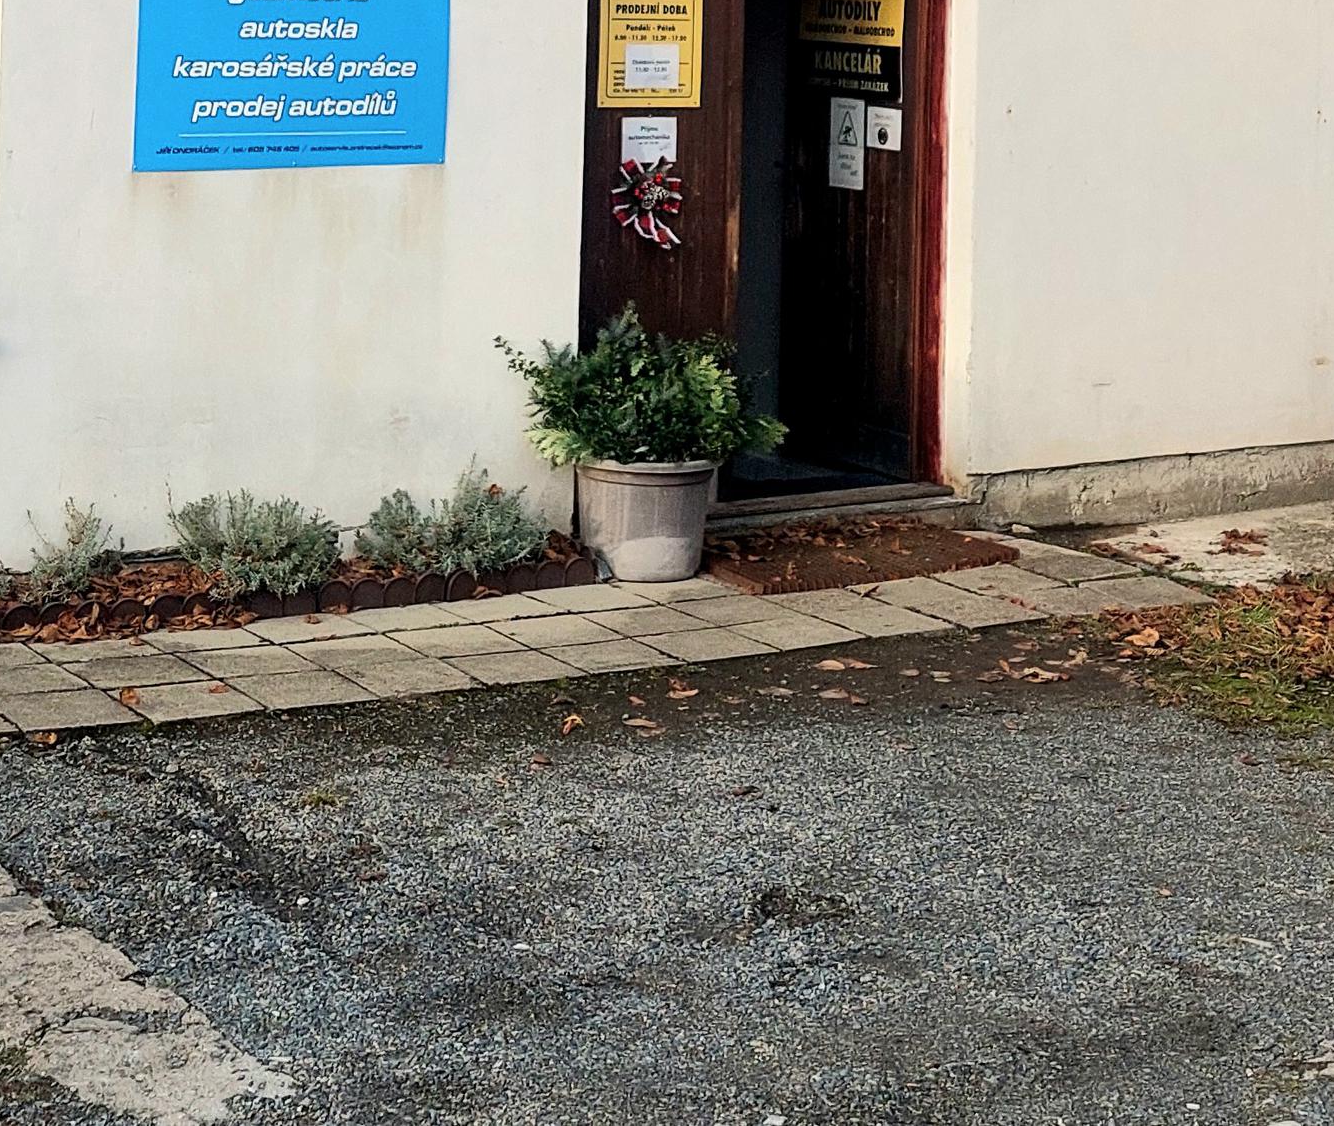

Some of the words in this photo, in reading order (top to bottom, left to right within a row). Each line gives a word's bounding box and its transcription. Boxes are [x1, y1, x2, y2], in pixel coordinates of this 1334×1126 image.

[616, 2, 660, 15] PRODEJNÍ
[663, 4, 688, 15] DOBA
[239, 17, 358, 40] autoskla
[173, 56, 335, 79] karosářské
[338, 54, 417, 83] práce
[815, 48, 882, 74] KANCELÁŘ
[191, 96, 286, 124] prodej
[288, 90, 397, 118] autodílů
